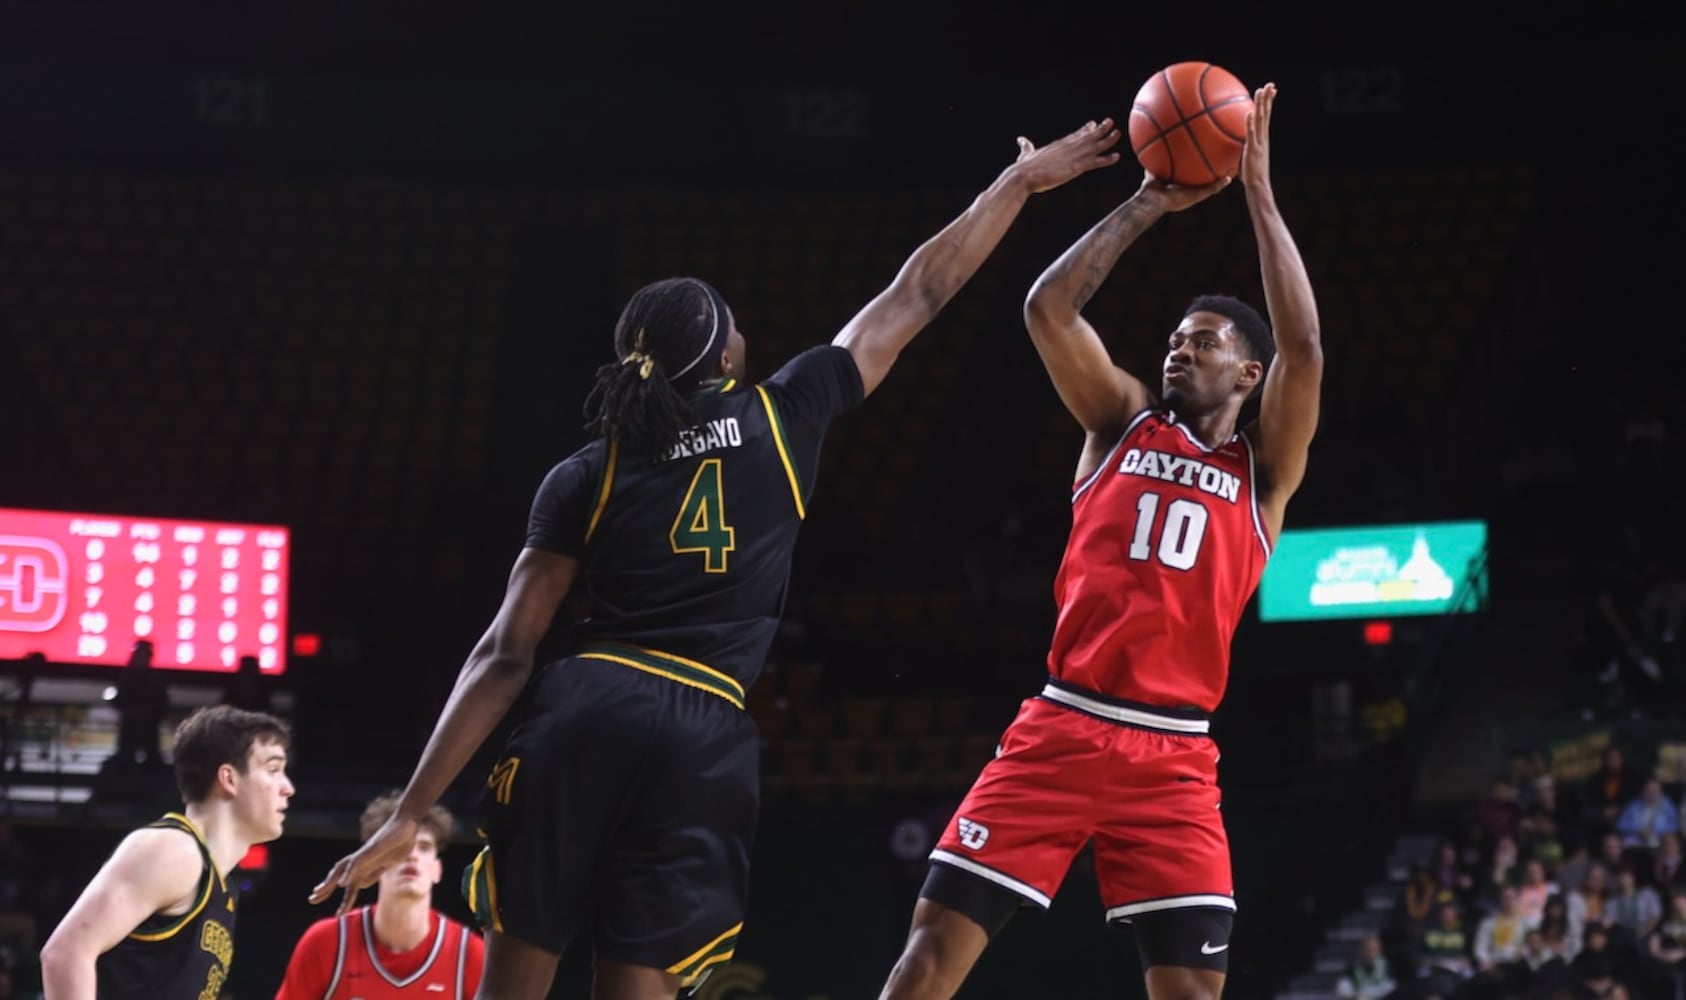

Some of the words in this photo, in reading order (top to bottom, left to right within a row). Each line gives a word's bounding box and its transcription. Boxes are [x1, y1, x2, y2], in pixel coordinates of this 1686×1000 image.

[190, 77, 265, 124] 121
[784, 90, 866, 136] 122
[1318, 67, 1404, 114] 122
[1119, 447, 1241, 504] DAYTON
[668, 458, 737, 574] 4
[1128, 491, 1209, 571] 10
